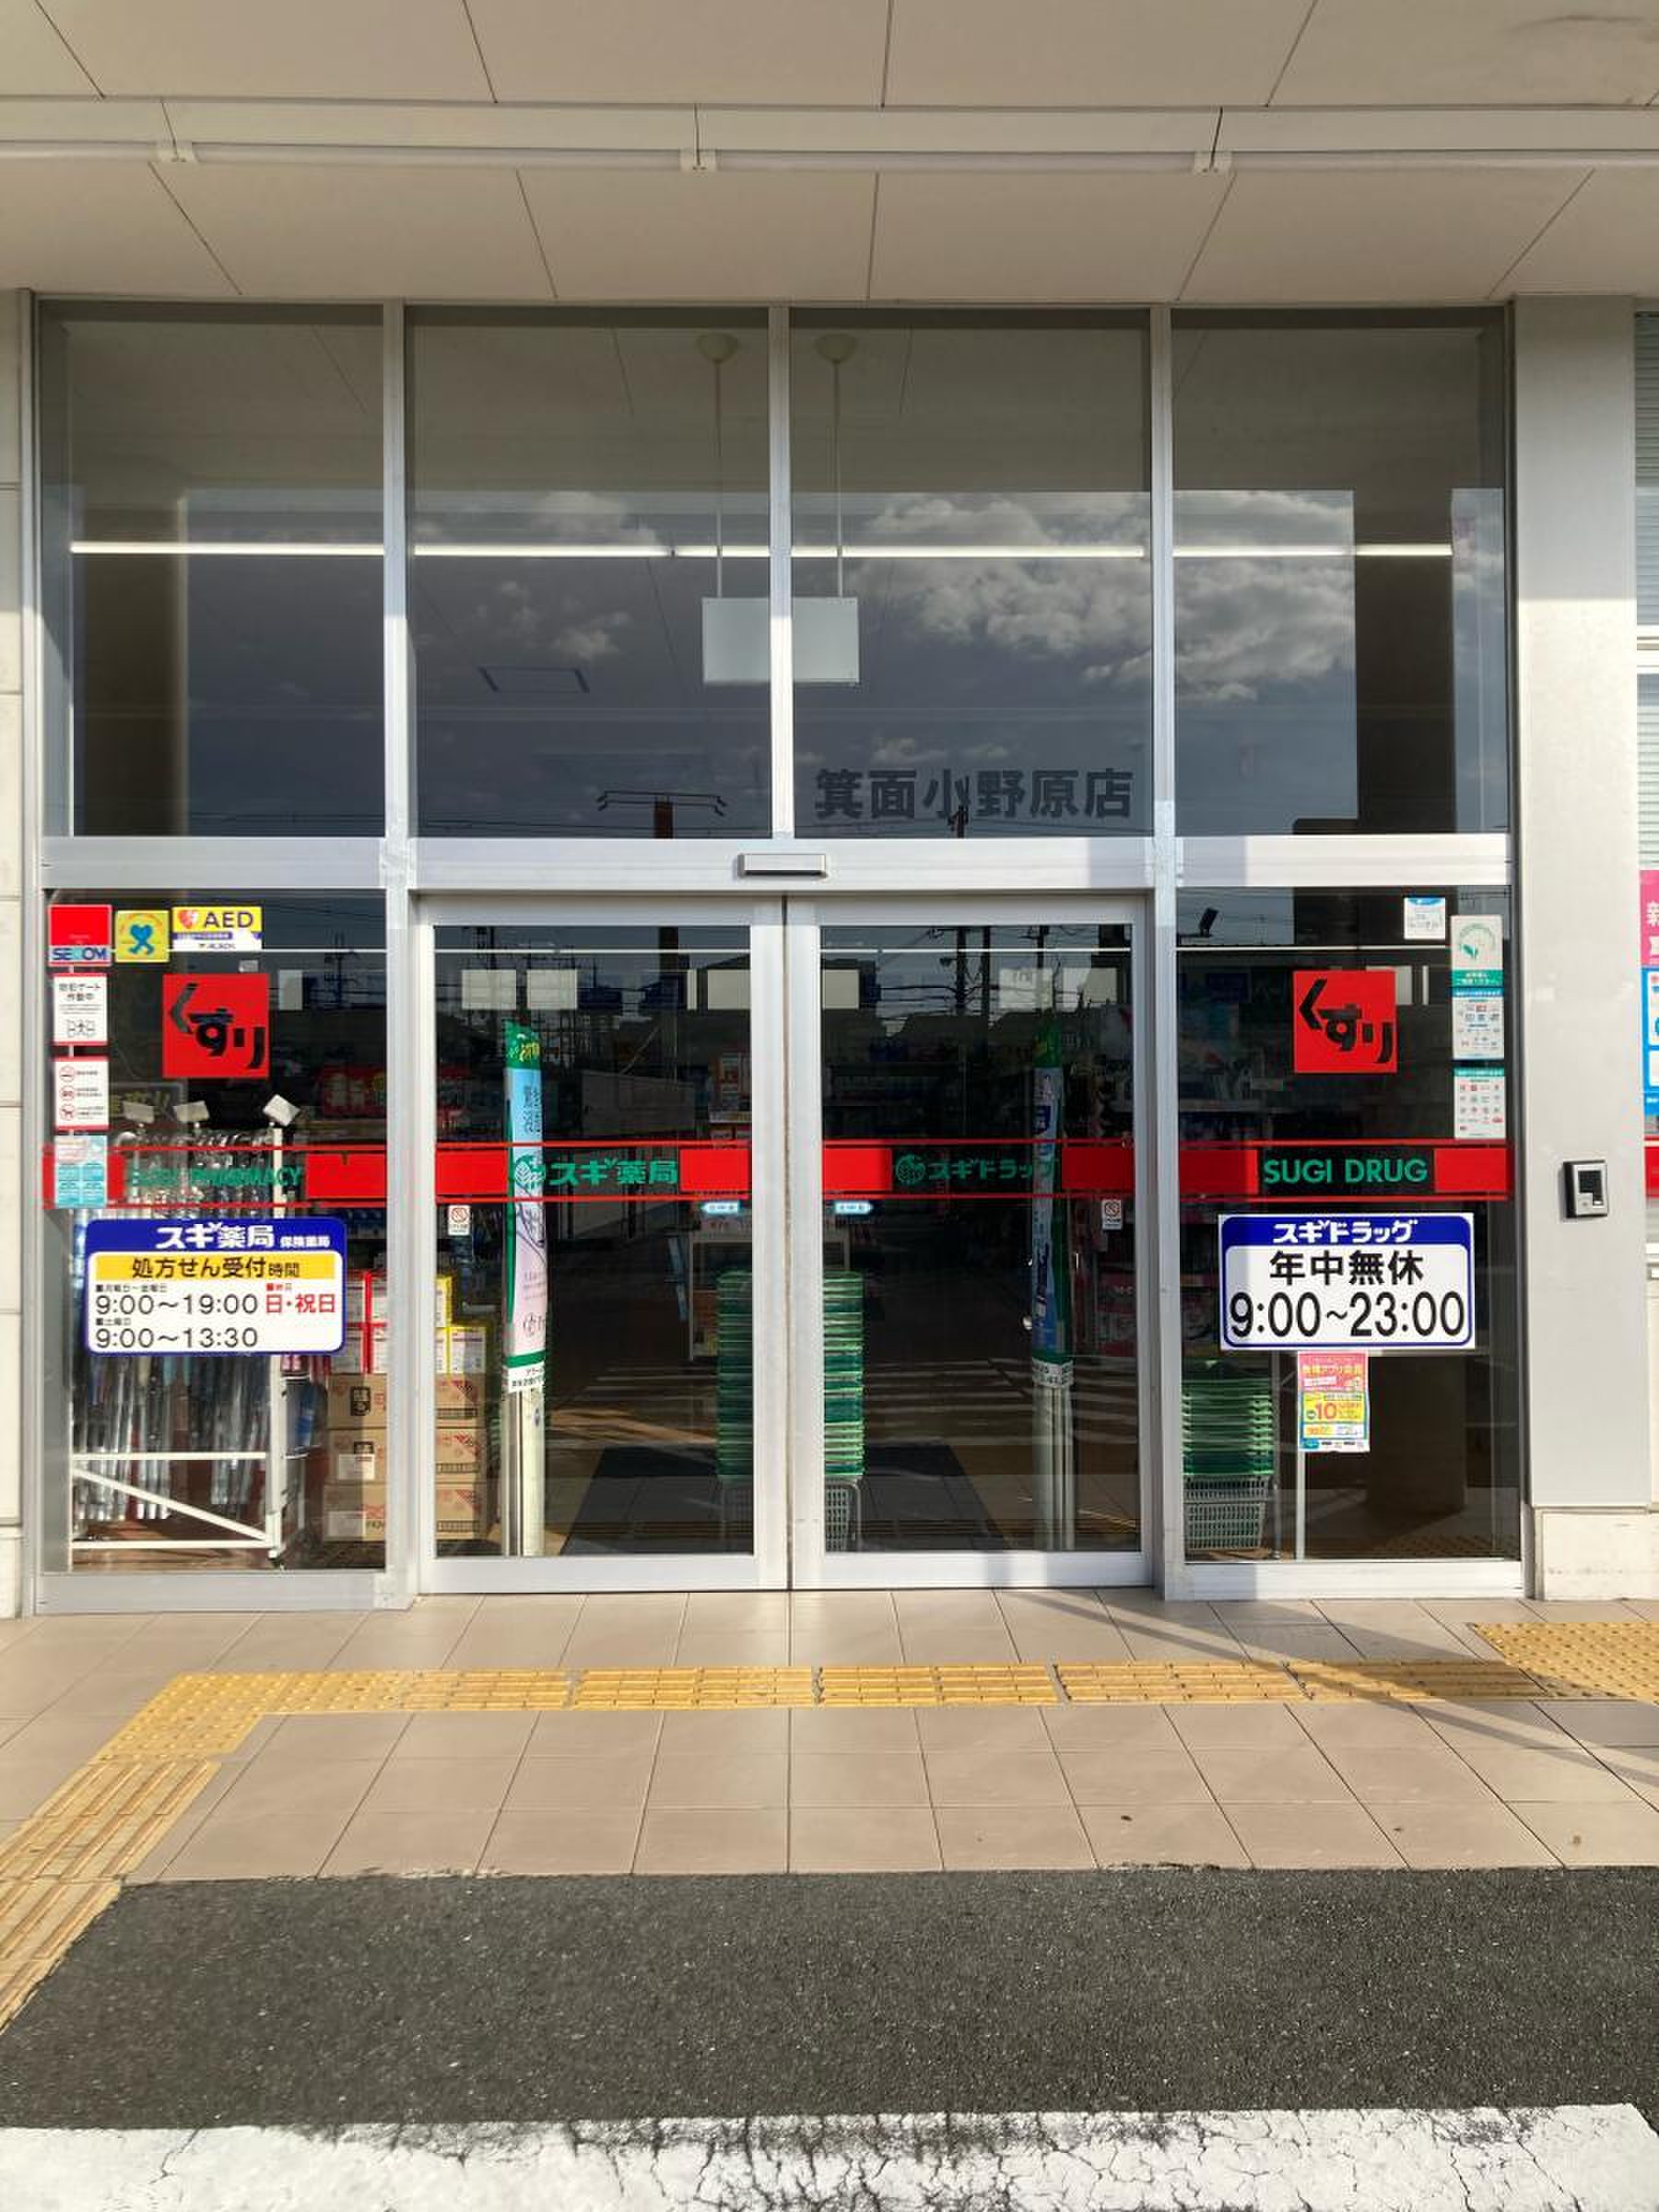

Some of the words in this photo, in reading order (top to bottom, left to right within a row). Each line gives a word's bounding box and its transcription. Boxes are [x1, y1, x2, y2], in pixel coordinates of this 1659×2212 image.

[815, 768, 1134, 819] 箕面小野原店
[203, 911, 253, 929] AED
[53, 947, 109, 960] SECOM
[169, 982, 265, 1069] くすり
[1299, 979, 1394, 1064] くすり
[548, 1158, 677, 1184] スギ薬局
[1263, 1159, 1333, 1184] SUGI
[1345, 1158, 1428, 1182] DRUG
[156, 1222, 274, 1249] スギ薬局
[1273, 1219, 1418, 1243] スギドラッグ
[1269, 1250, 1424, 1286] 年中無休
